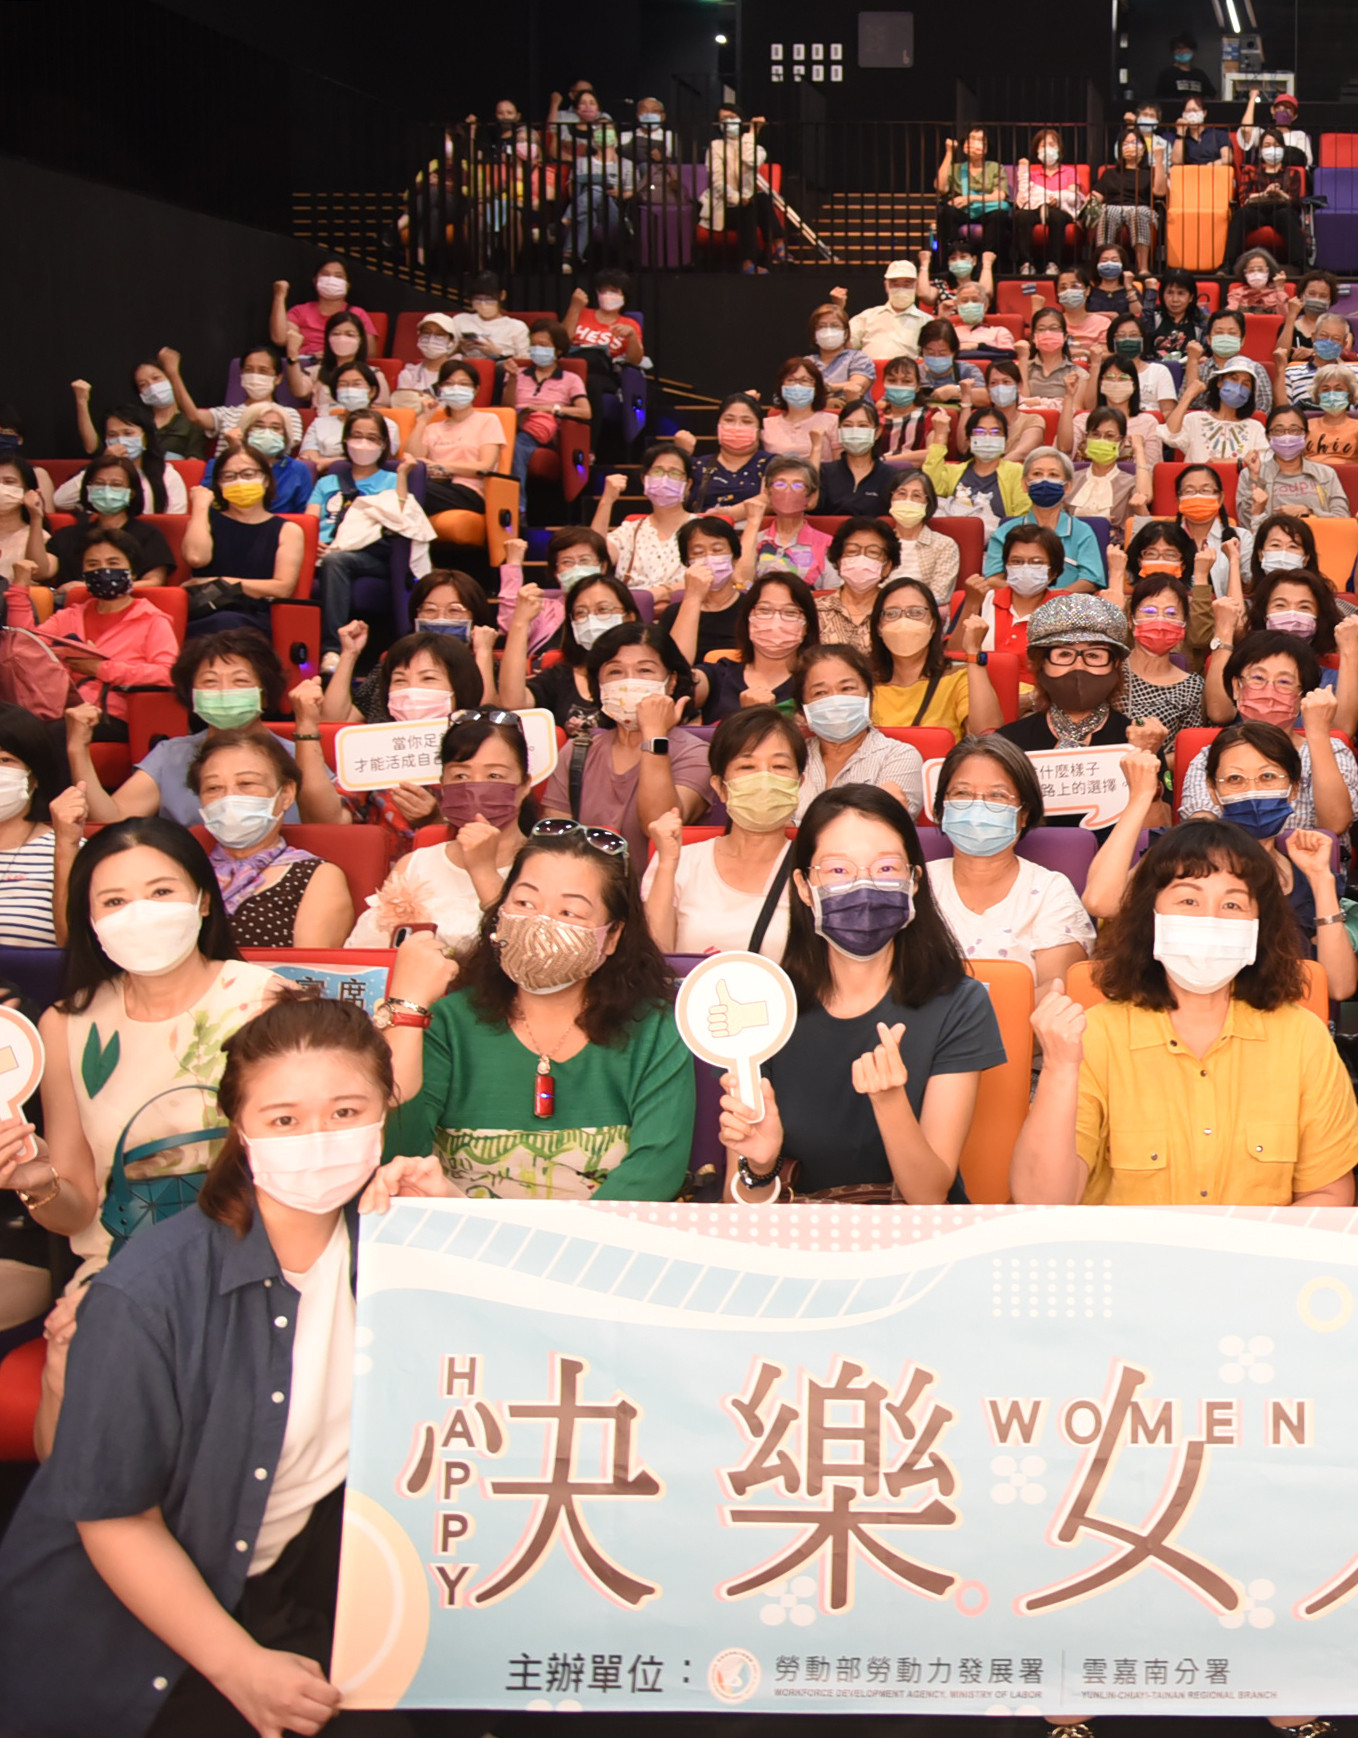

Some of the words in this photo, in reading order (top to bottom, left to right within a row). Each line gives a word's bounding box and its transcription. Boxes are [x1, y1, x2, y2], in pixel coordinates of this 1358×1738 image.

[575, 325, 625, 349] HESS
[391, 732, 444, 751] 當你足
[988, 1399, 1306, 1446] WOMEN
[435, 1356, 478, 1607] HAPPY
[505, 1653, 691, 1693] 主辦單位：
[774, 1655, 1045, 1685] 勞動部勞動力發展署
[1082, 1658, 1231, 1686] 雲嘉南分署
[774, 1688, 833, 1697] WORKFORCE
[836, 1689, 905, 1698] DEVELOPMENT
[1187, 1690, 1235, 1699] REGIONAL
[1237, 1690, 1278, 1699] BRANCH
